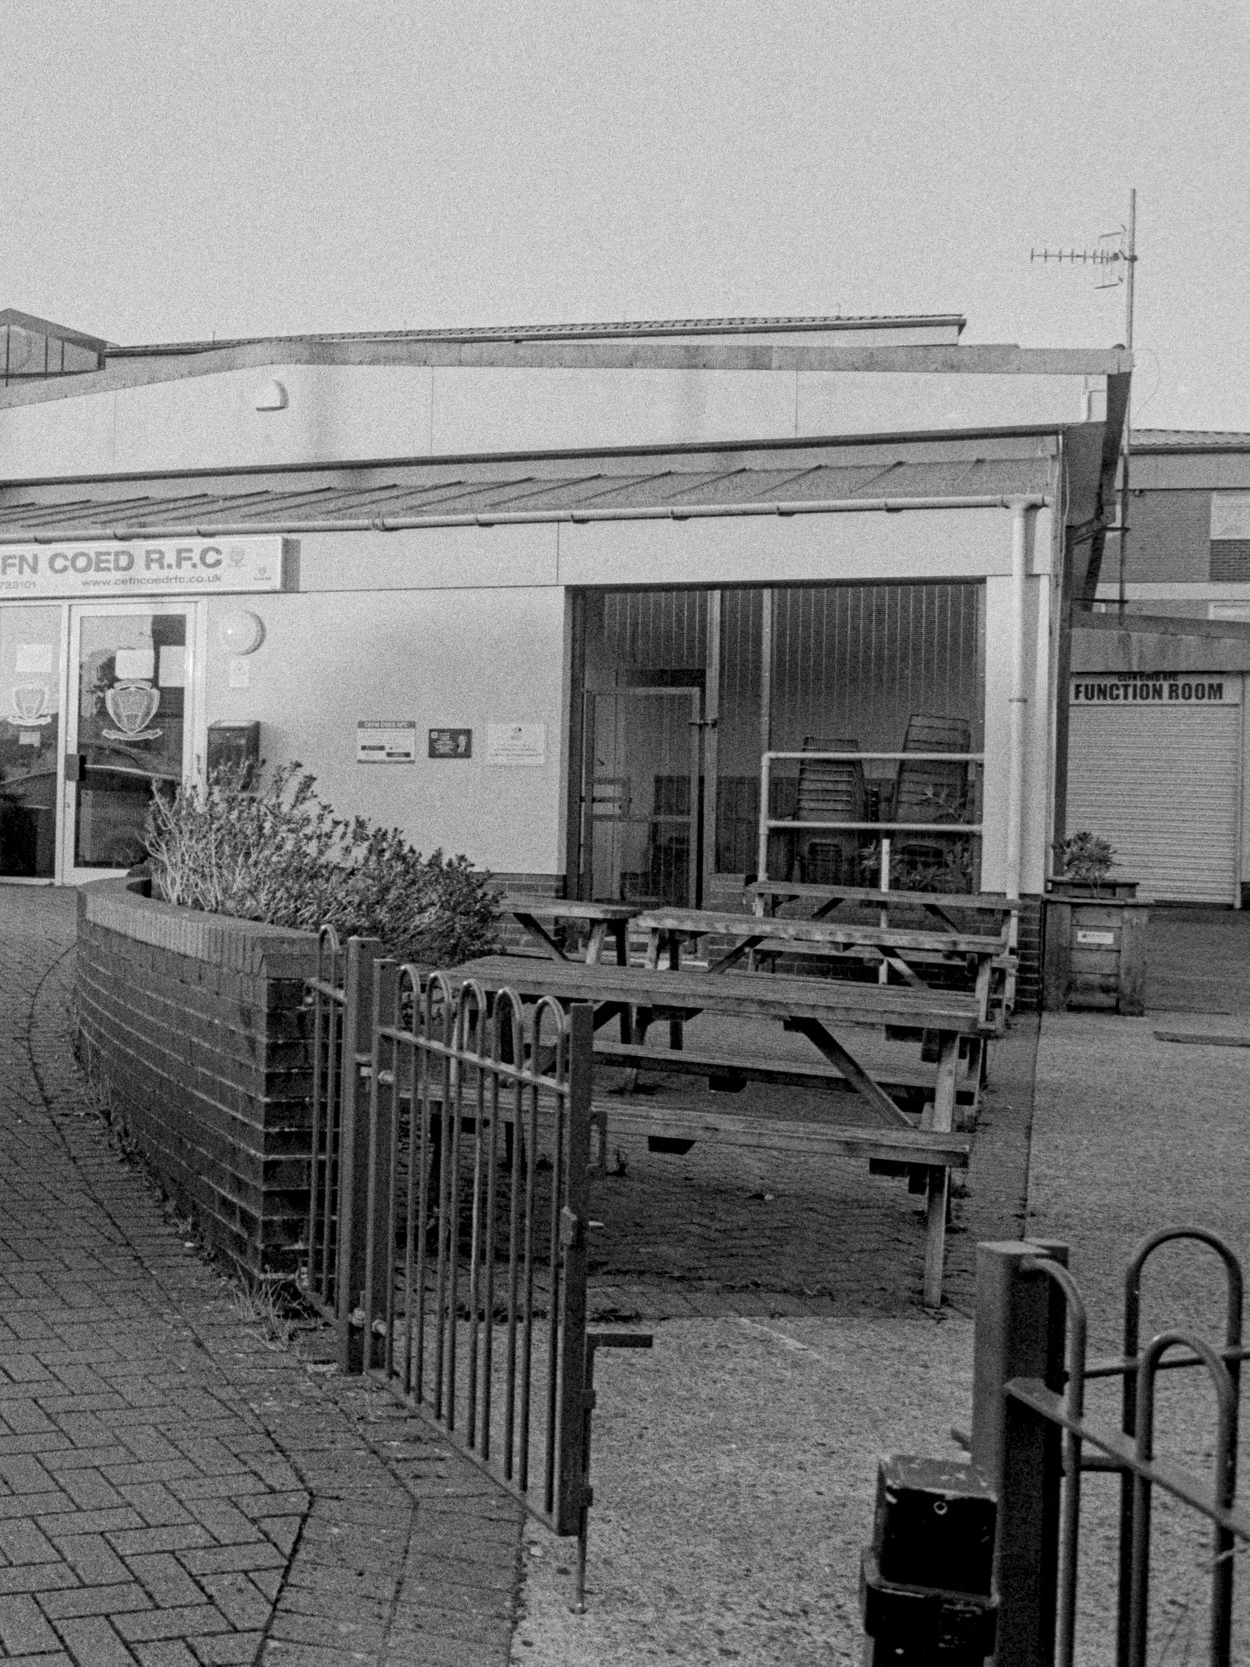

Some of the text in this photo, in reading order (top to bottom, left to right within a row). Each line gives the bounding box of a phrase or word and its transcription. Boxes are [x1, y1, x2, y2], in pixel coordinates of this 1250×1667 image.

[48, 550, 135, 574] COED
[144, 546, 223, 571] R.F.C
[82, 573, 222, 587] www.cefncoedrfc.co.uk
[1074, 682, 1224, 701] FUNCTION ROOM
